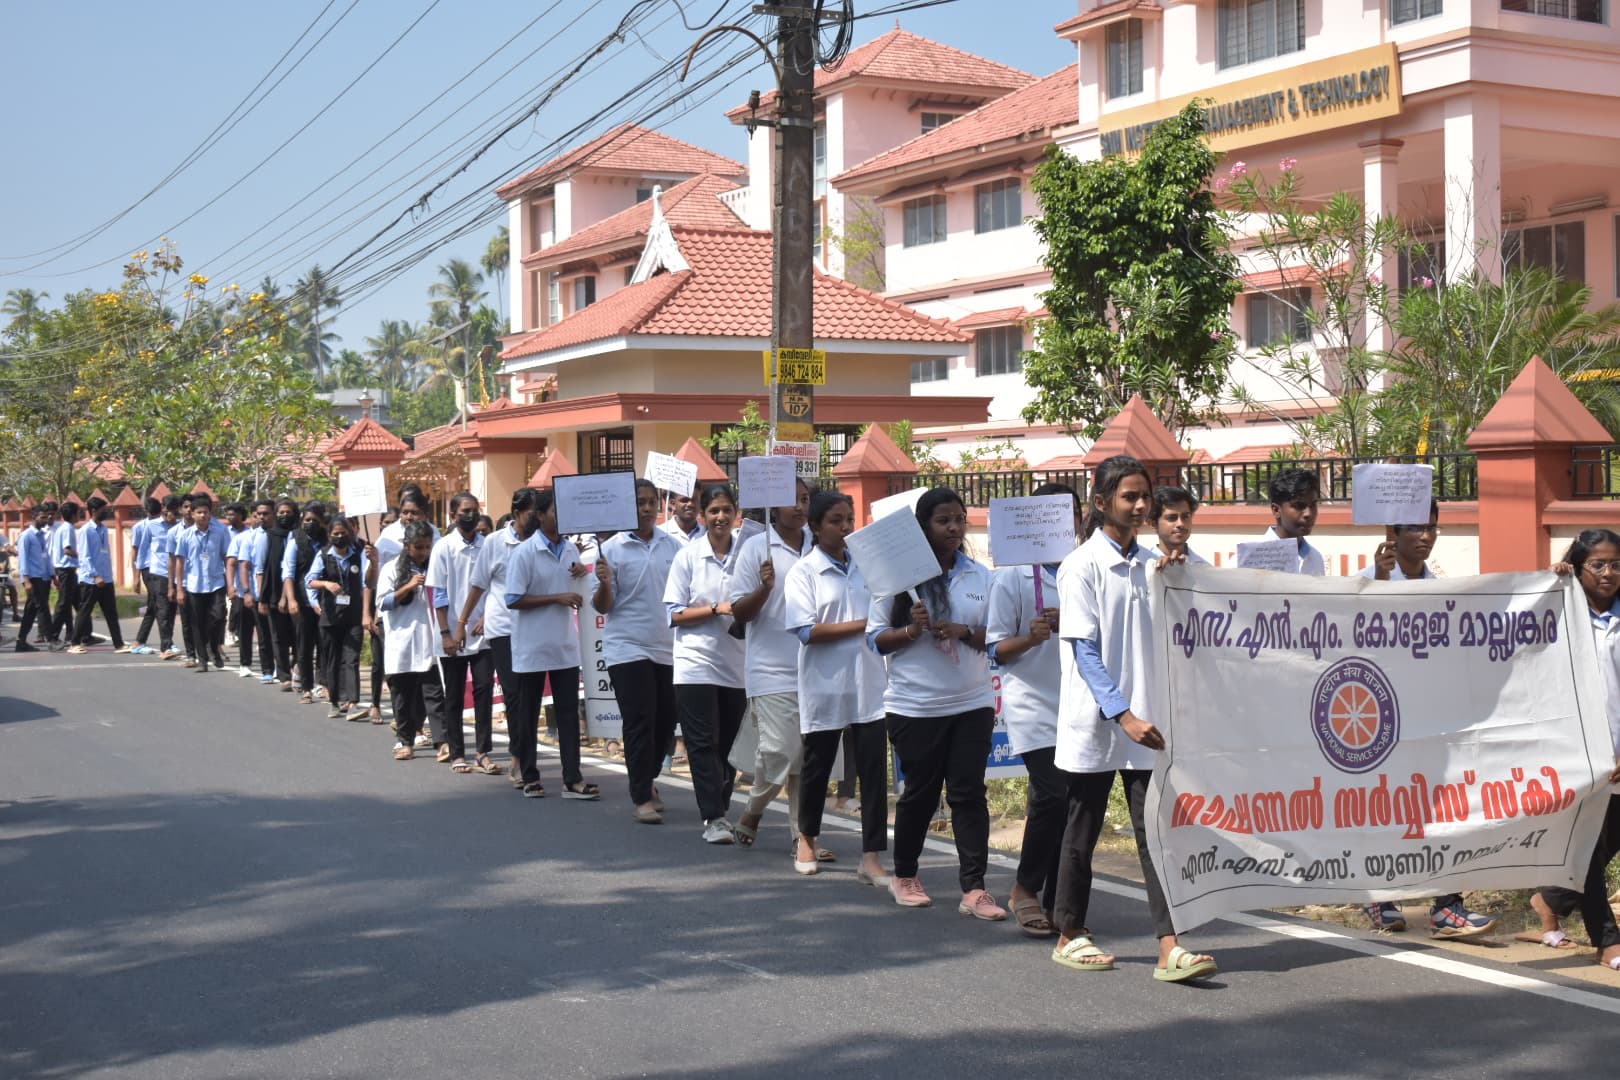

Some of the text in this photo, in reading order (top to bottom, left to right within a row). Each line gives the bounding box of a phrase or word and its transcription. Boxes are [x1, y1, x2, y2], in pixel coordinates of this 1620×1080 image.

[1288, 88, 1298, 116] &
[1299, 65, 1390, 113] TECHNOLOGY
[780, 364, 823, 380] 9846 724 884
[789, 403, 808, 416] 107
[804, 460, 817, 473] 331
[1353, 600, 1456, 659] കോളേജ്
[1342, 663, 1362, 679] सेवा
[1363, 670, 1389, 702] योजना
[1320, 722, 1392, 763] NATIONAL SERVICE SCHEME
[1171, 765, 1576, 840] നാഷണൽ സർവ്വീസ് സ്കീം
[1519, 828, 1548, 848] 47
